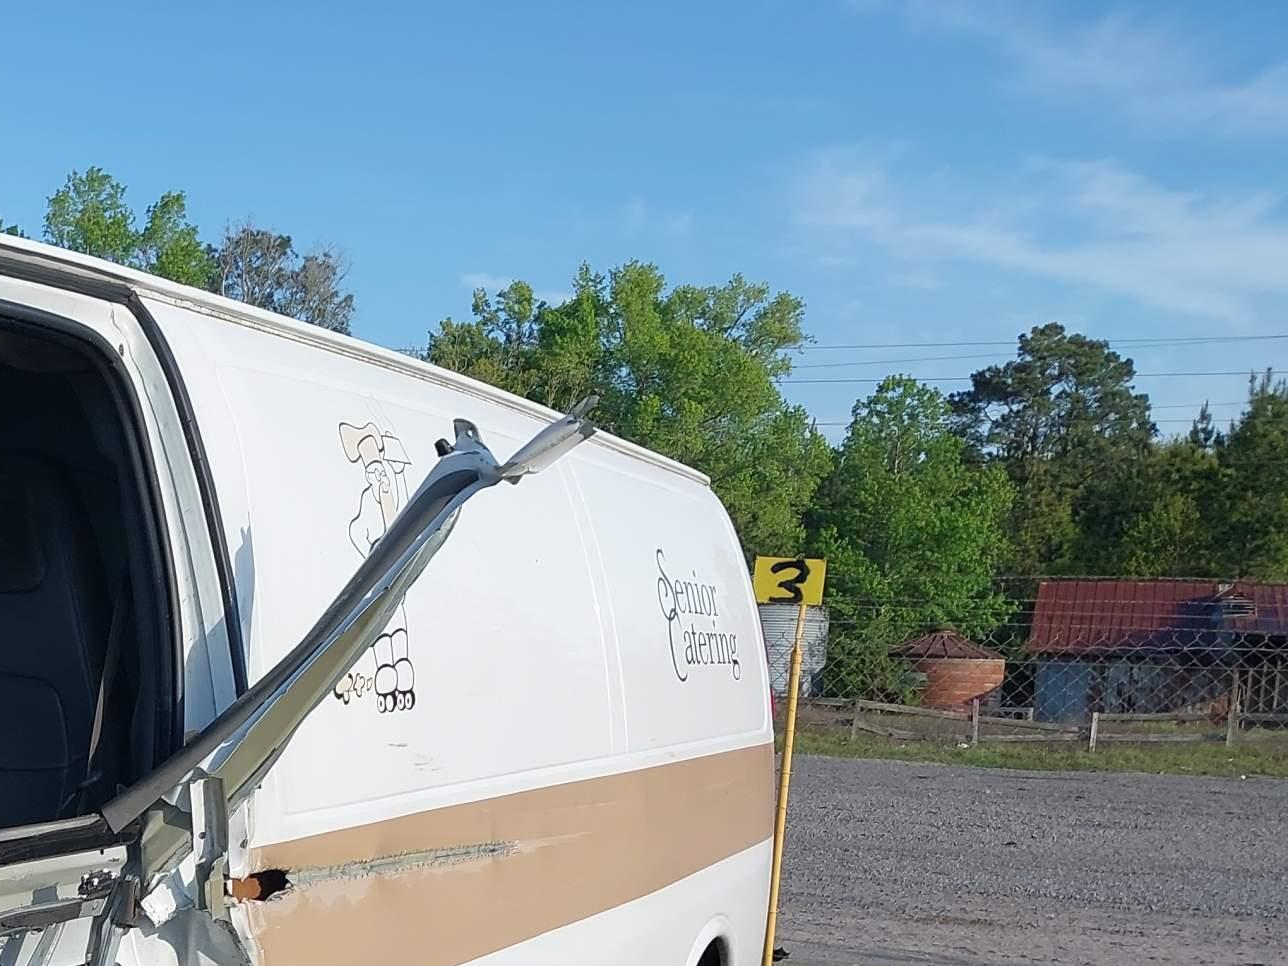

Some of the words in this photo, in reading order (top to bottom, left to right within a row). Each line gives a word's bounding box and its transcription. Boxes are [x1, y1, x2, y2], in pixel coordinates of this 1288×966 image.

[656, 549, 719, 621] Senior
[769, 560, 810, 603] 3
[668, 609, 741, 681] Catering
